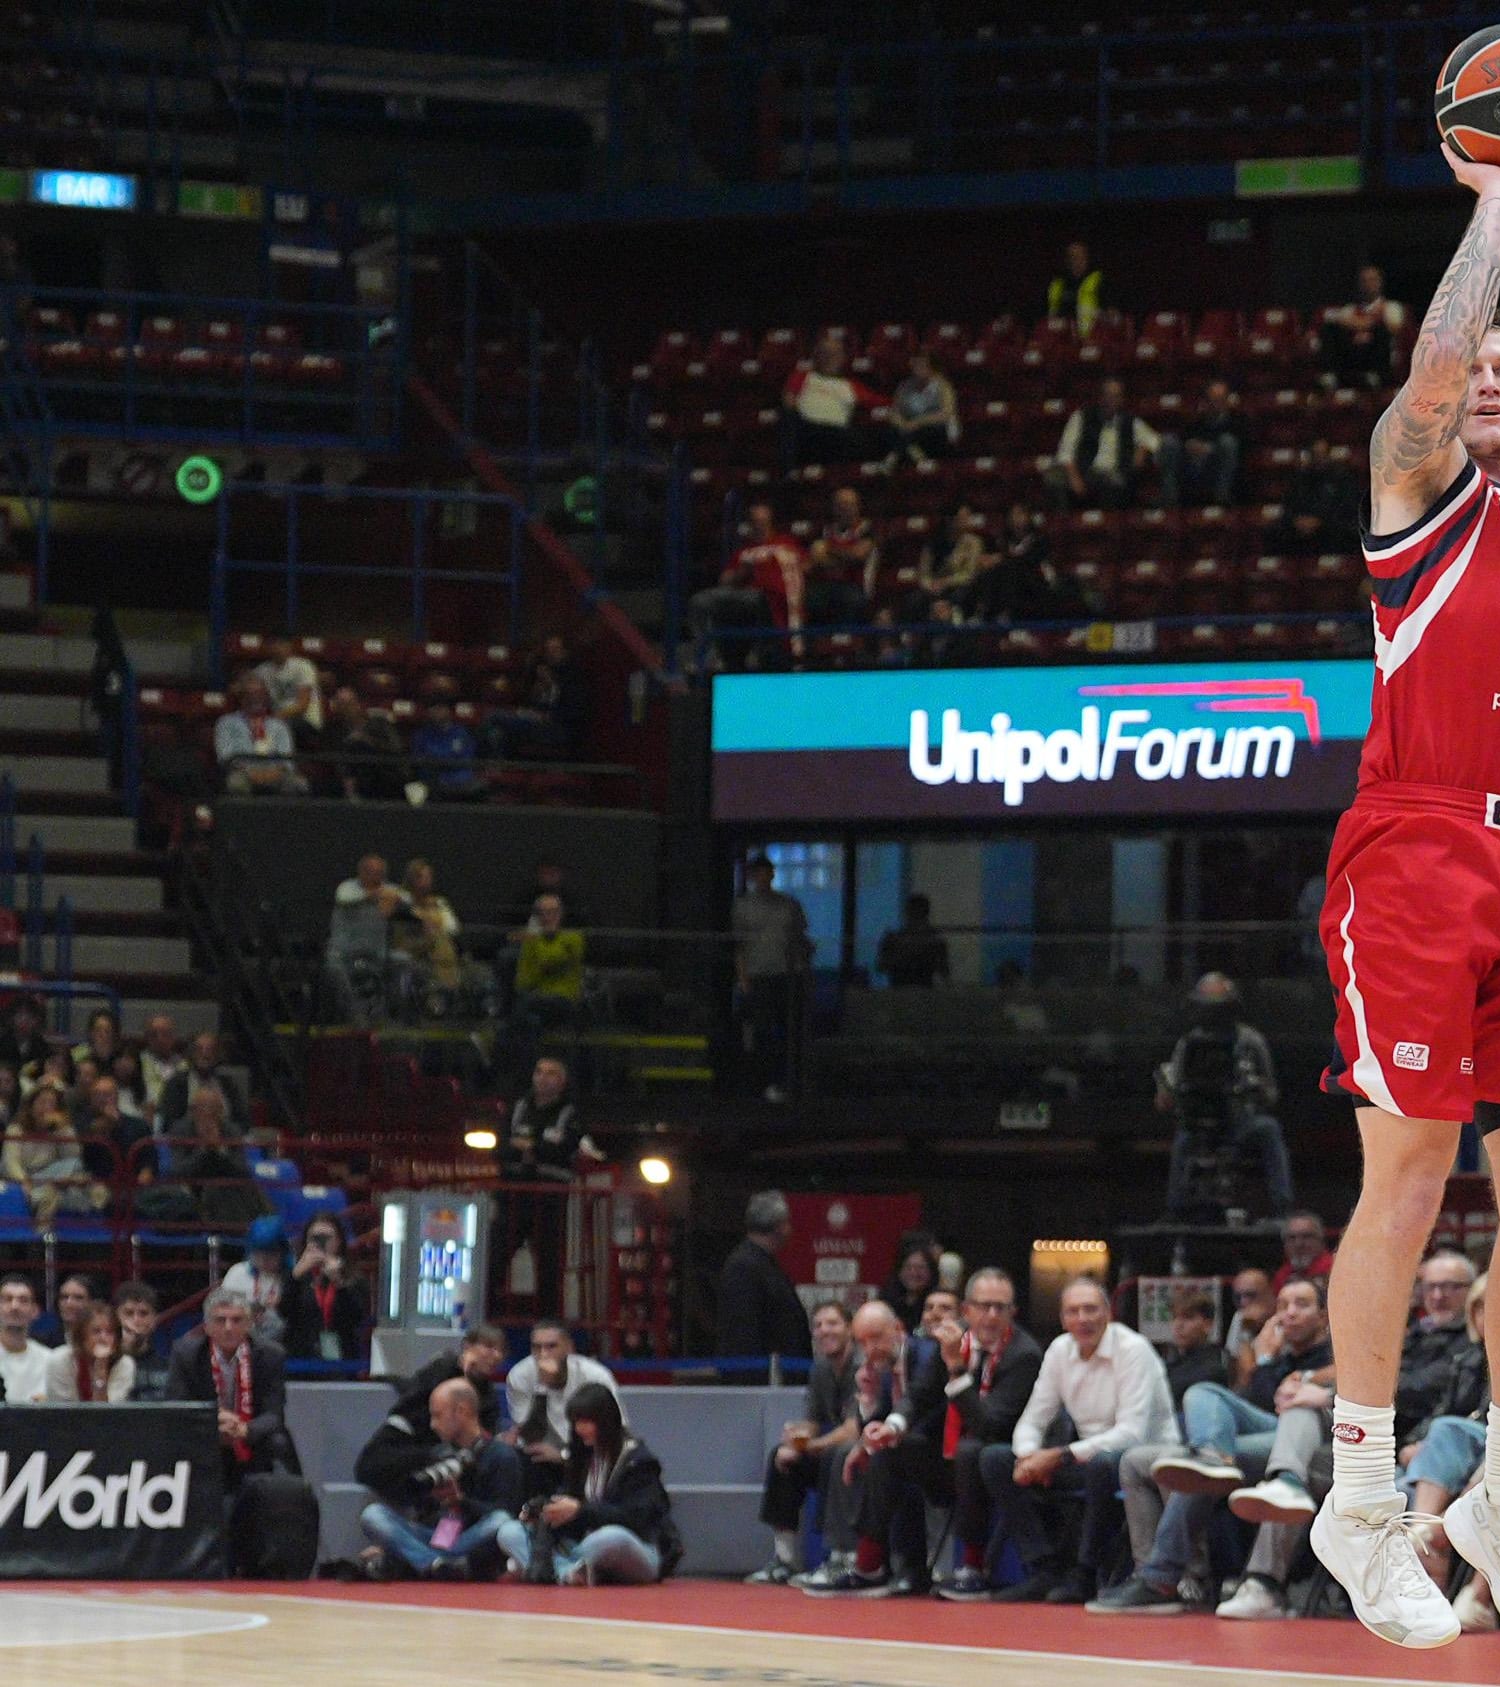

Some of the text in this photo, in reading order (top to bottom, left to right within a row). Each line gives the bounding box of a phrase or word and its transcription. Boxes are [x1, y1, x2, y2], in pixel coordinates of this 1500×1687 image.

[56, 173, 110, 206] BAR
[909, 705, 1296, 807] UnipolForum
[1396, 1045, 1426, 1058] EA7
